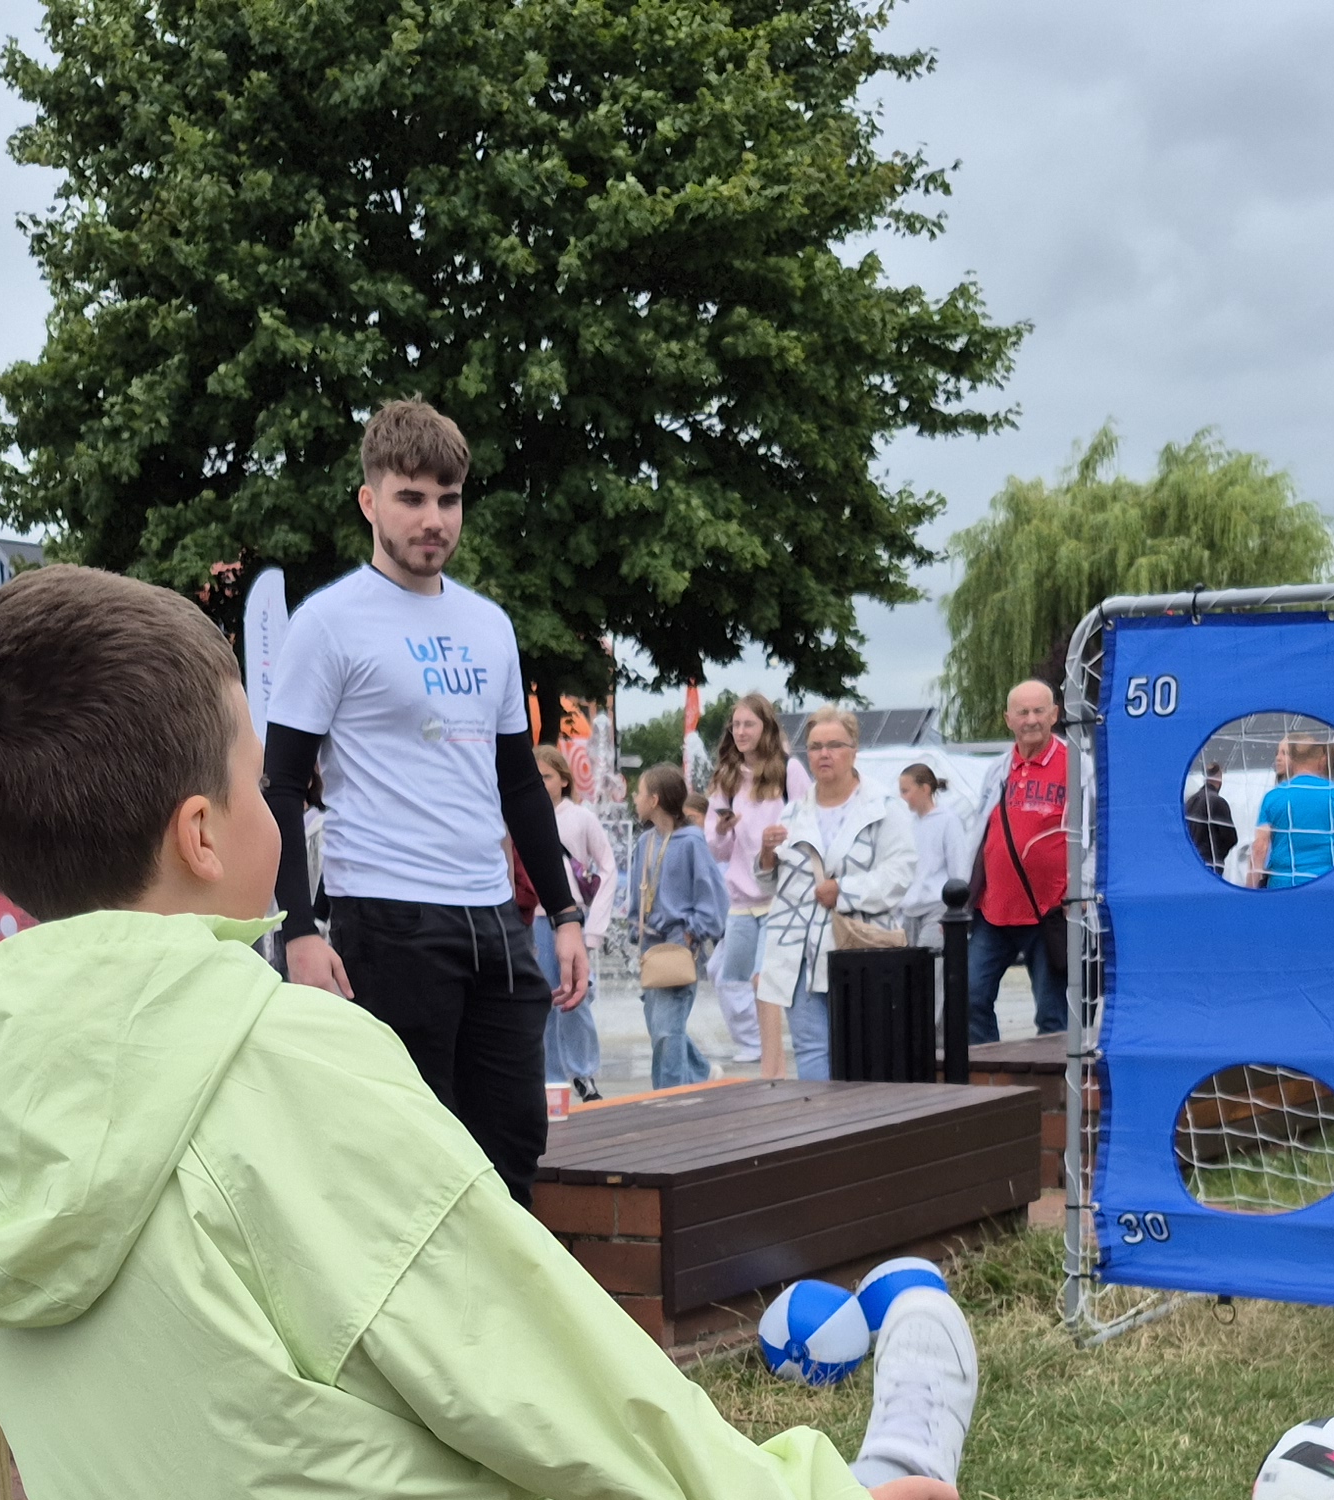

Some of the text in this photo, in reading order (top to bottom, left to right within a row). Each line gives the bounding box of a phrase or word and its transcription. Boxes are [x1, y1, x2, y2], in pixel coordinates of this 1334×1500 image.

[423, 667, 488, 695] AWF
[1125, 675, 1178, 718] 50
[1117, 1210, 1170, 1244] 30
